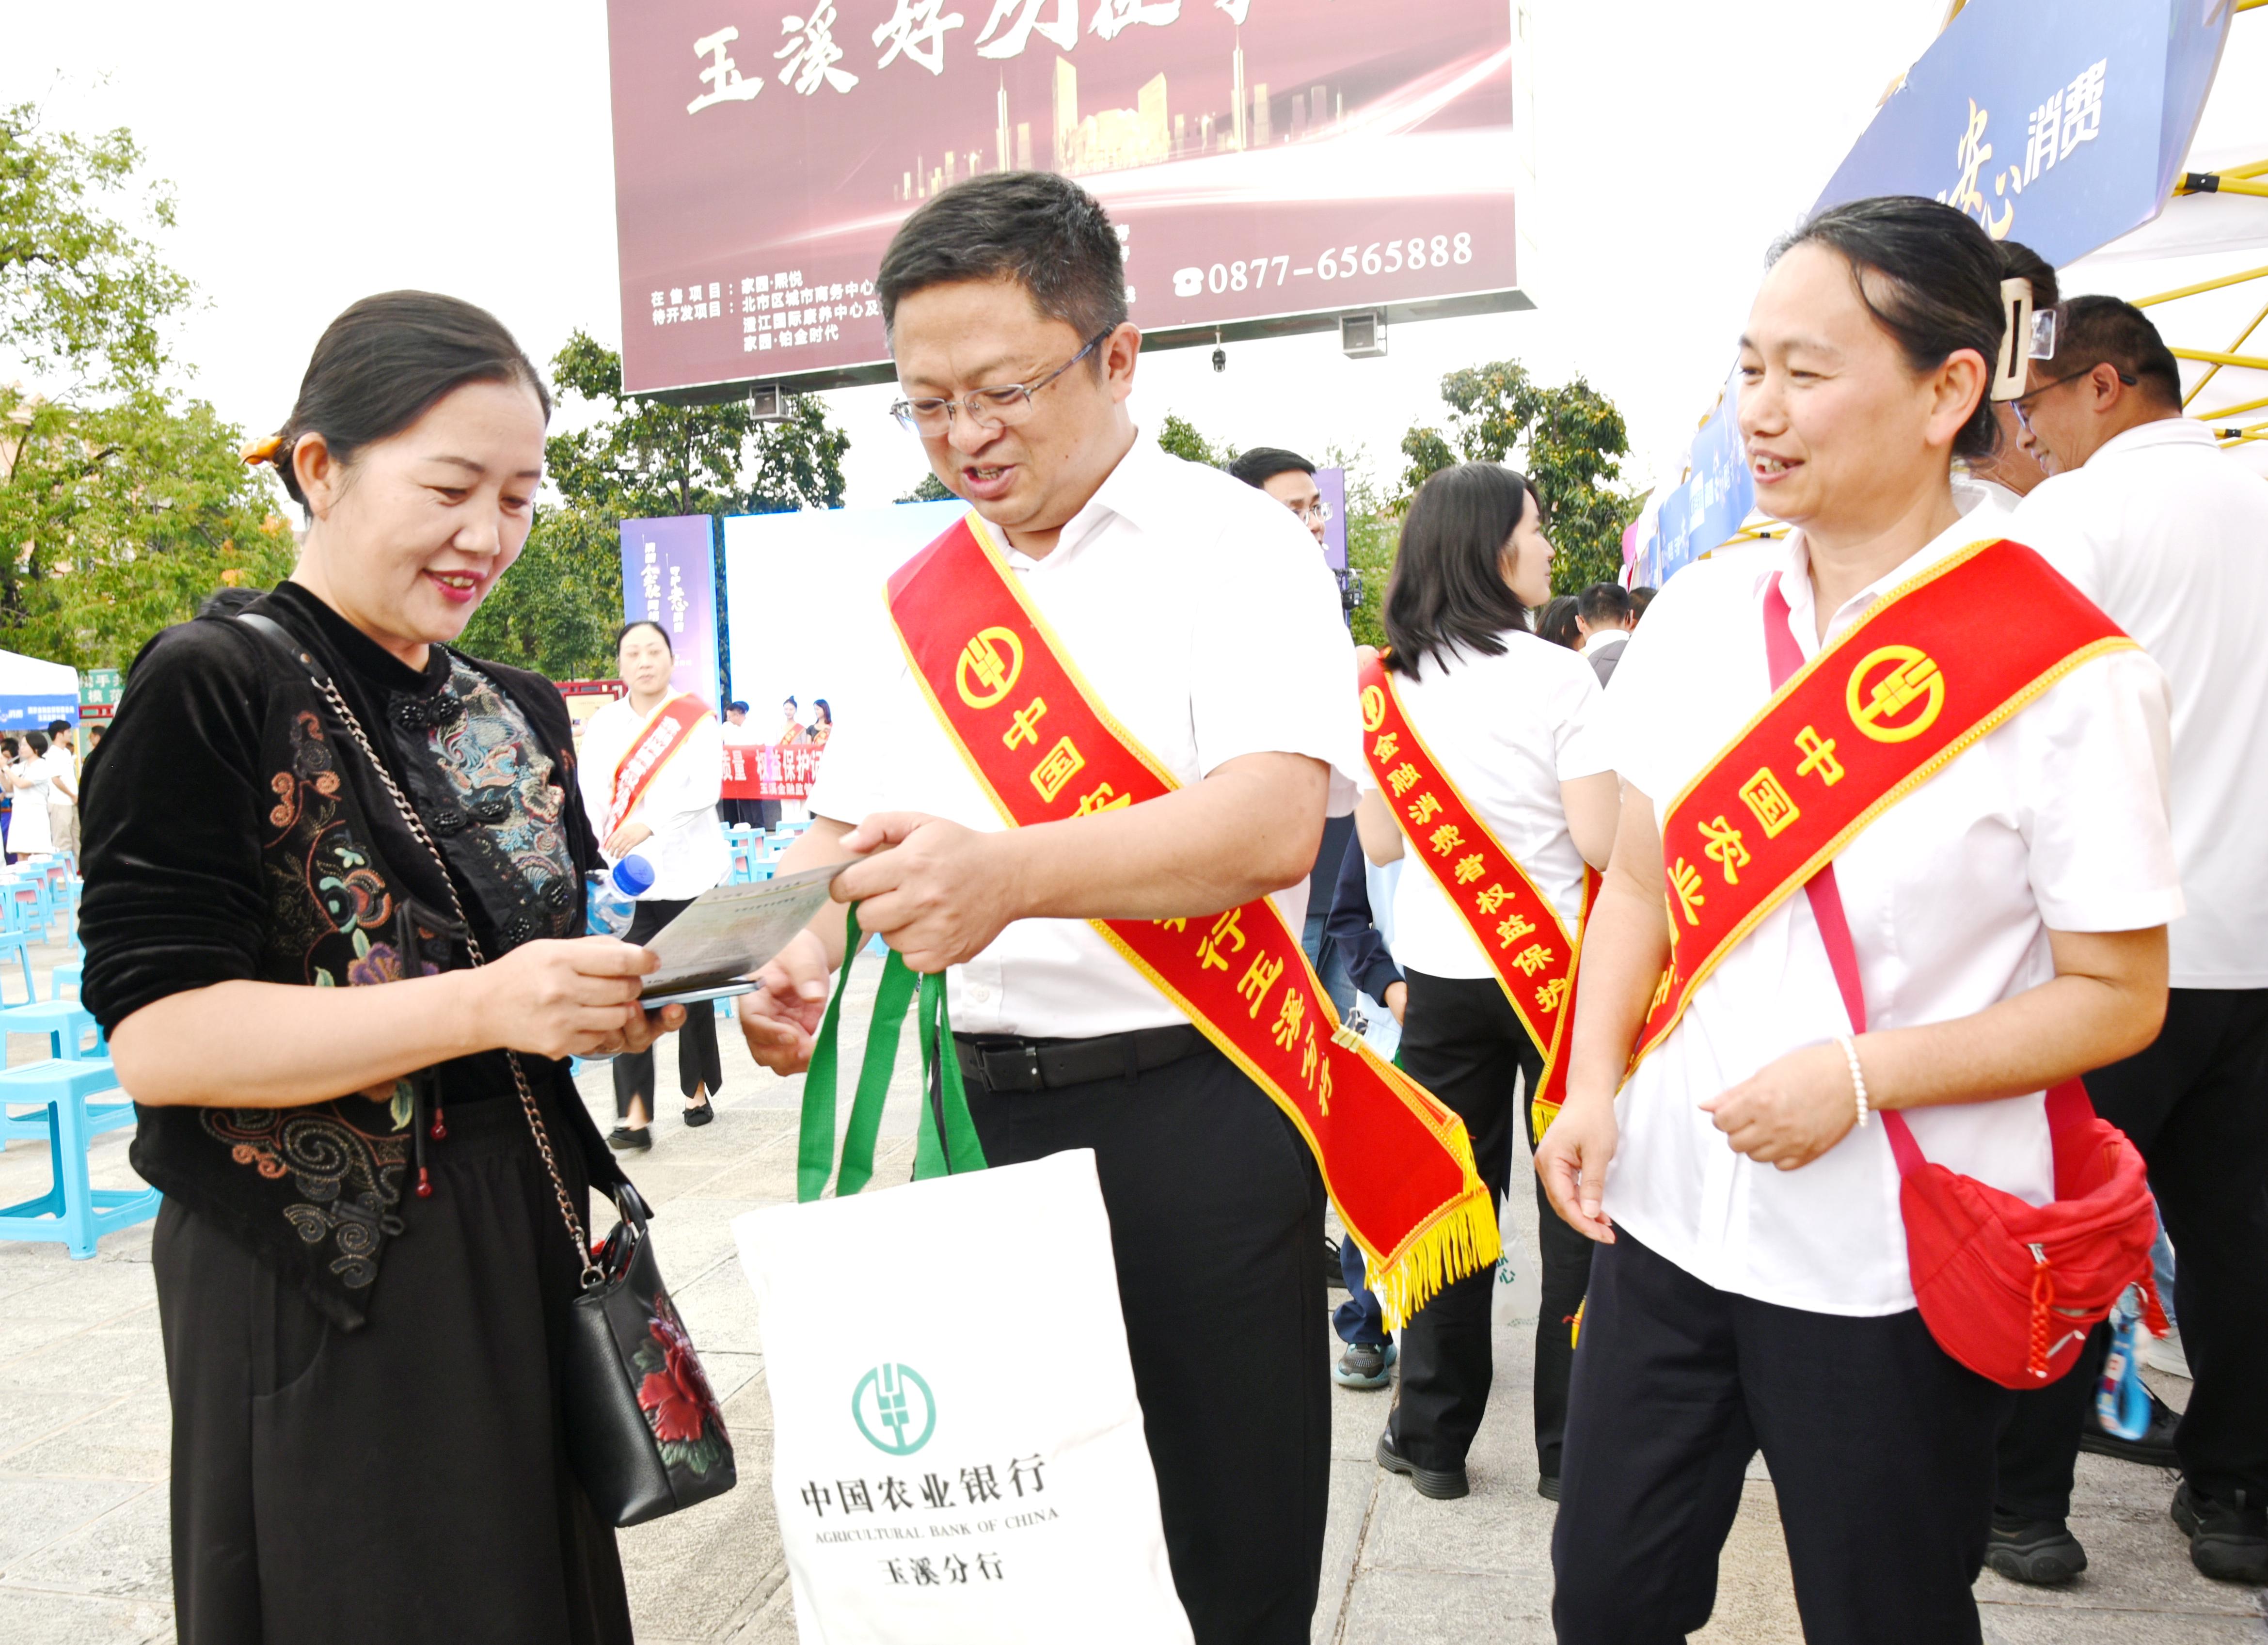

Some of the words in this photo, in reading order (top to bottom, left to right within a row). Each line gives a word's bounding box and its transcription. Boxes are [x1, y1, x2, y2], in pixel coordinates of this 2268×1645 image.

[1935, 57, 2107, 241] 安心消费
[1207, 232, 1473, 294] 0877-6565888
[1373, 732, 1567, 1013] 金融消费者权益保护
[1647, 725, 1844, 1024] 中国农业
[801, 1453, 1046, 1518] 中国农业银行
[815, 1527, 924, 1544] AGRICULTURAL
[930, 1523, 972, 1537] BANK
[978, 1519, 998, 1534] OF
[1005, 1506, 1060, 1530] CHINA
[878, 1551, 1004, 1586] 玉溪分行
